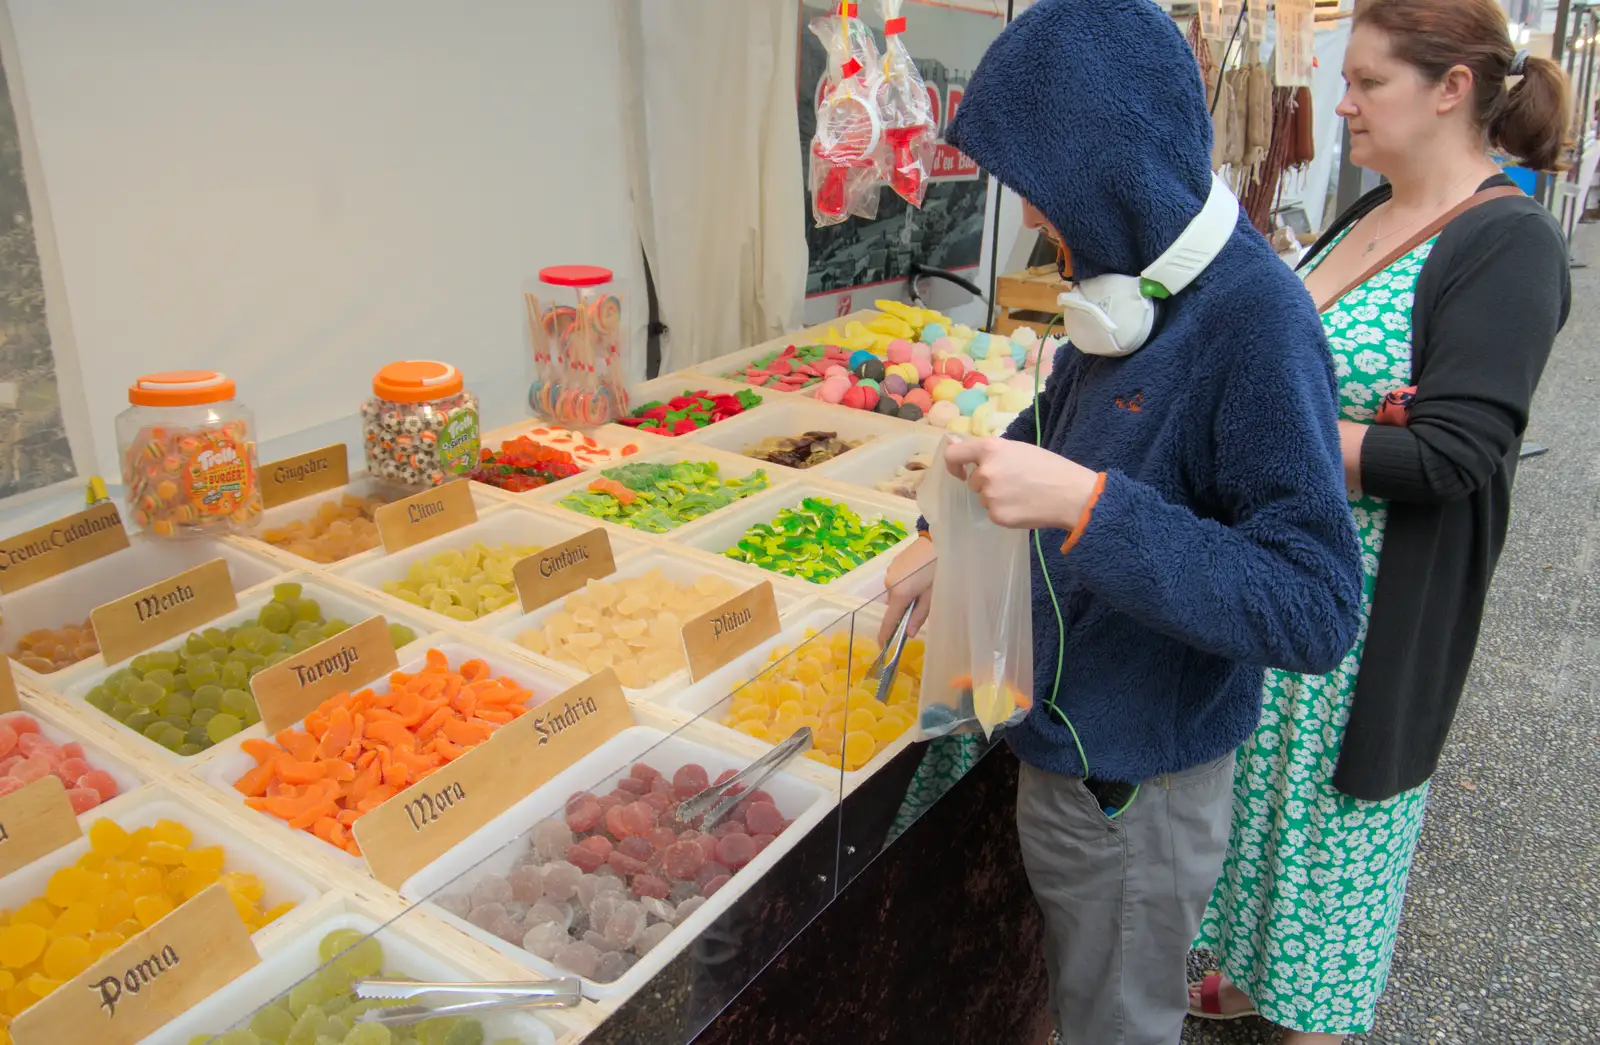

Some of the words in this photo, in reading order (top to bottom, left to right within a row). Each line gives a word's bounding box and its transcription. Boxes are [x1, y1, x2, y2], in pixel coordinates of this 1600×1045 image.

[208, 468, 242, 485] BURGER
[133, 584, 195, 623] Menta
[288, 645, 360, 689] Taronja
[403, 780, 467, 833] Mora
[87, 943, 180, 1020] Poma
